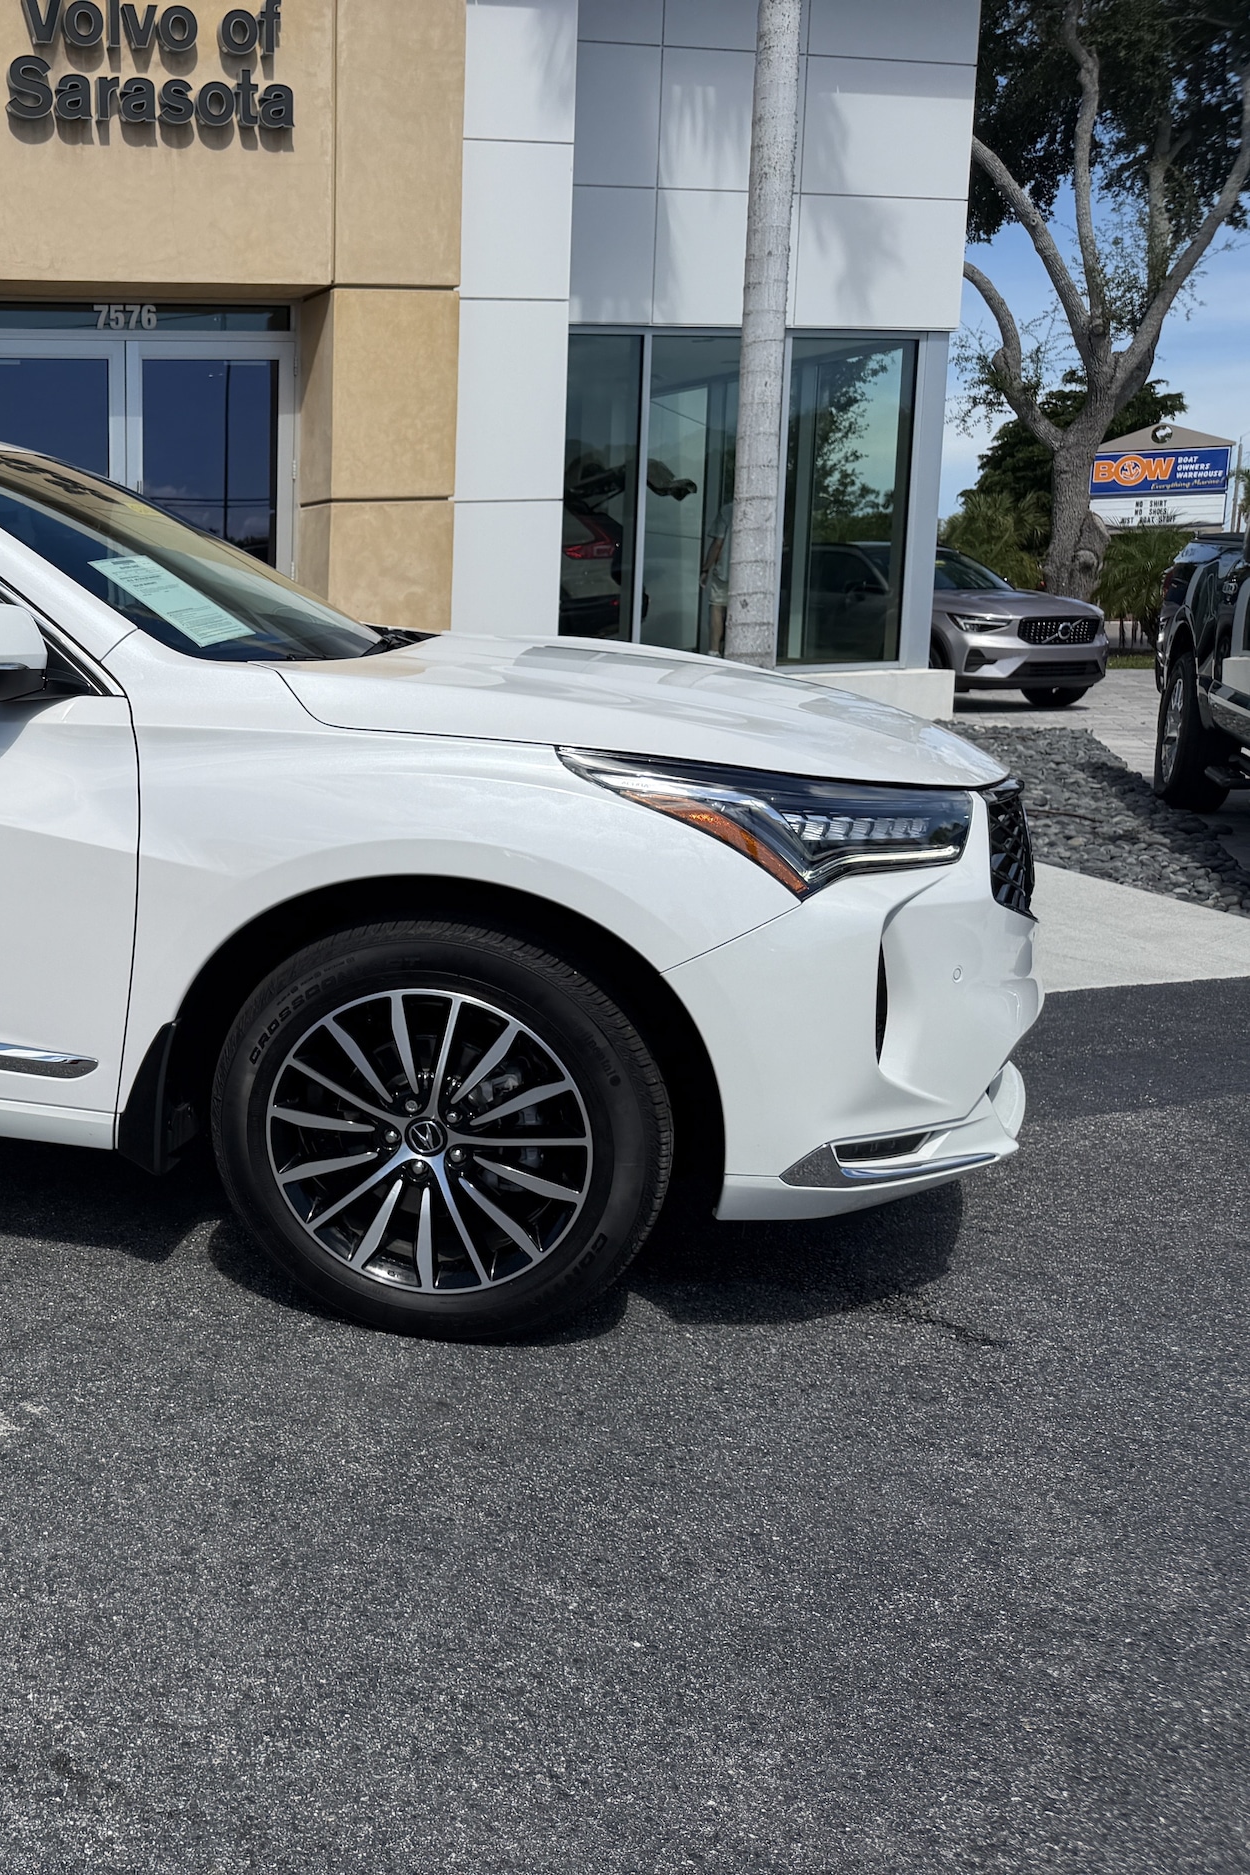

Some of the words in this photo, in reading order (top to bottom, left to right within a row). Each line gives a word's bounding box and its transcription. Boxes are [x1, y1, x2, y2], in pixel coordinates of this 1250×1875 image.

[21, 0, 198, 51] Volvo
[218, 0, 281, 55] of
[6, 55, 295, 128] Sarasota
[93, 304, 157, 330] 7576
[1177, 456, 1199, 464] BOAT
[1093, 454, 1175, 487] BOW
[1176, 463, 1211, 471] OWNERS
[1176, 470, 1223, 479] WAREHOUSE
[1151, 482, 1190, 490] Everything
[1135, 500, 1143, 508] NO
[1149, 500, 1167, 508] SHIRT
[1134, 508, 1143, 516] NO
